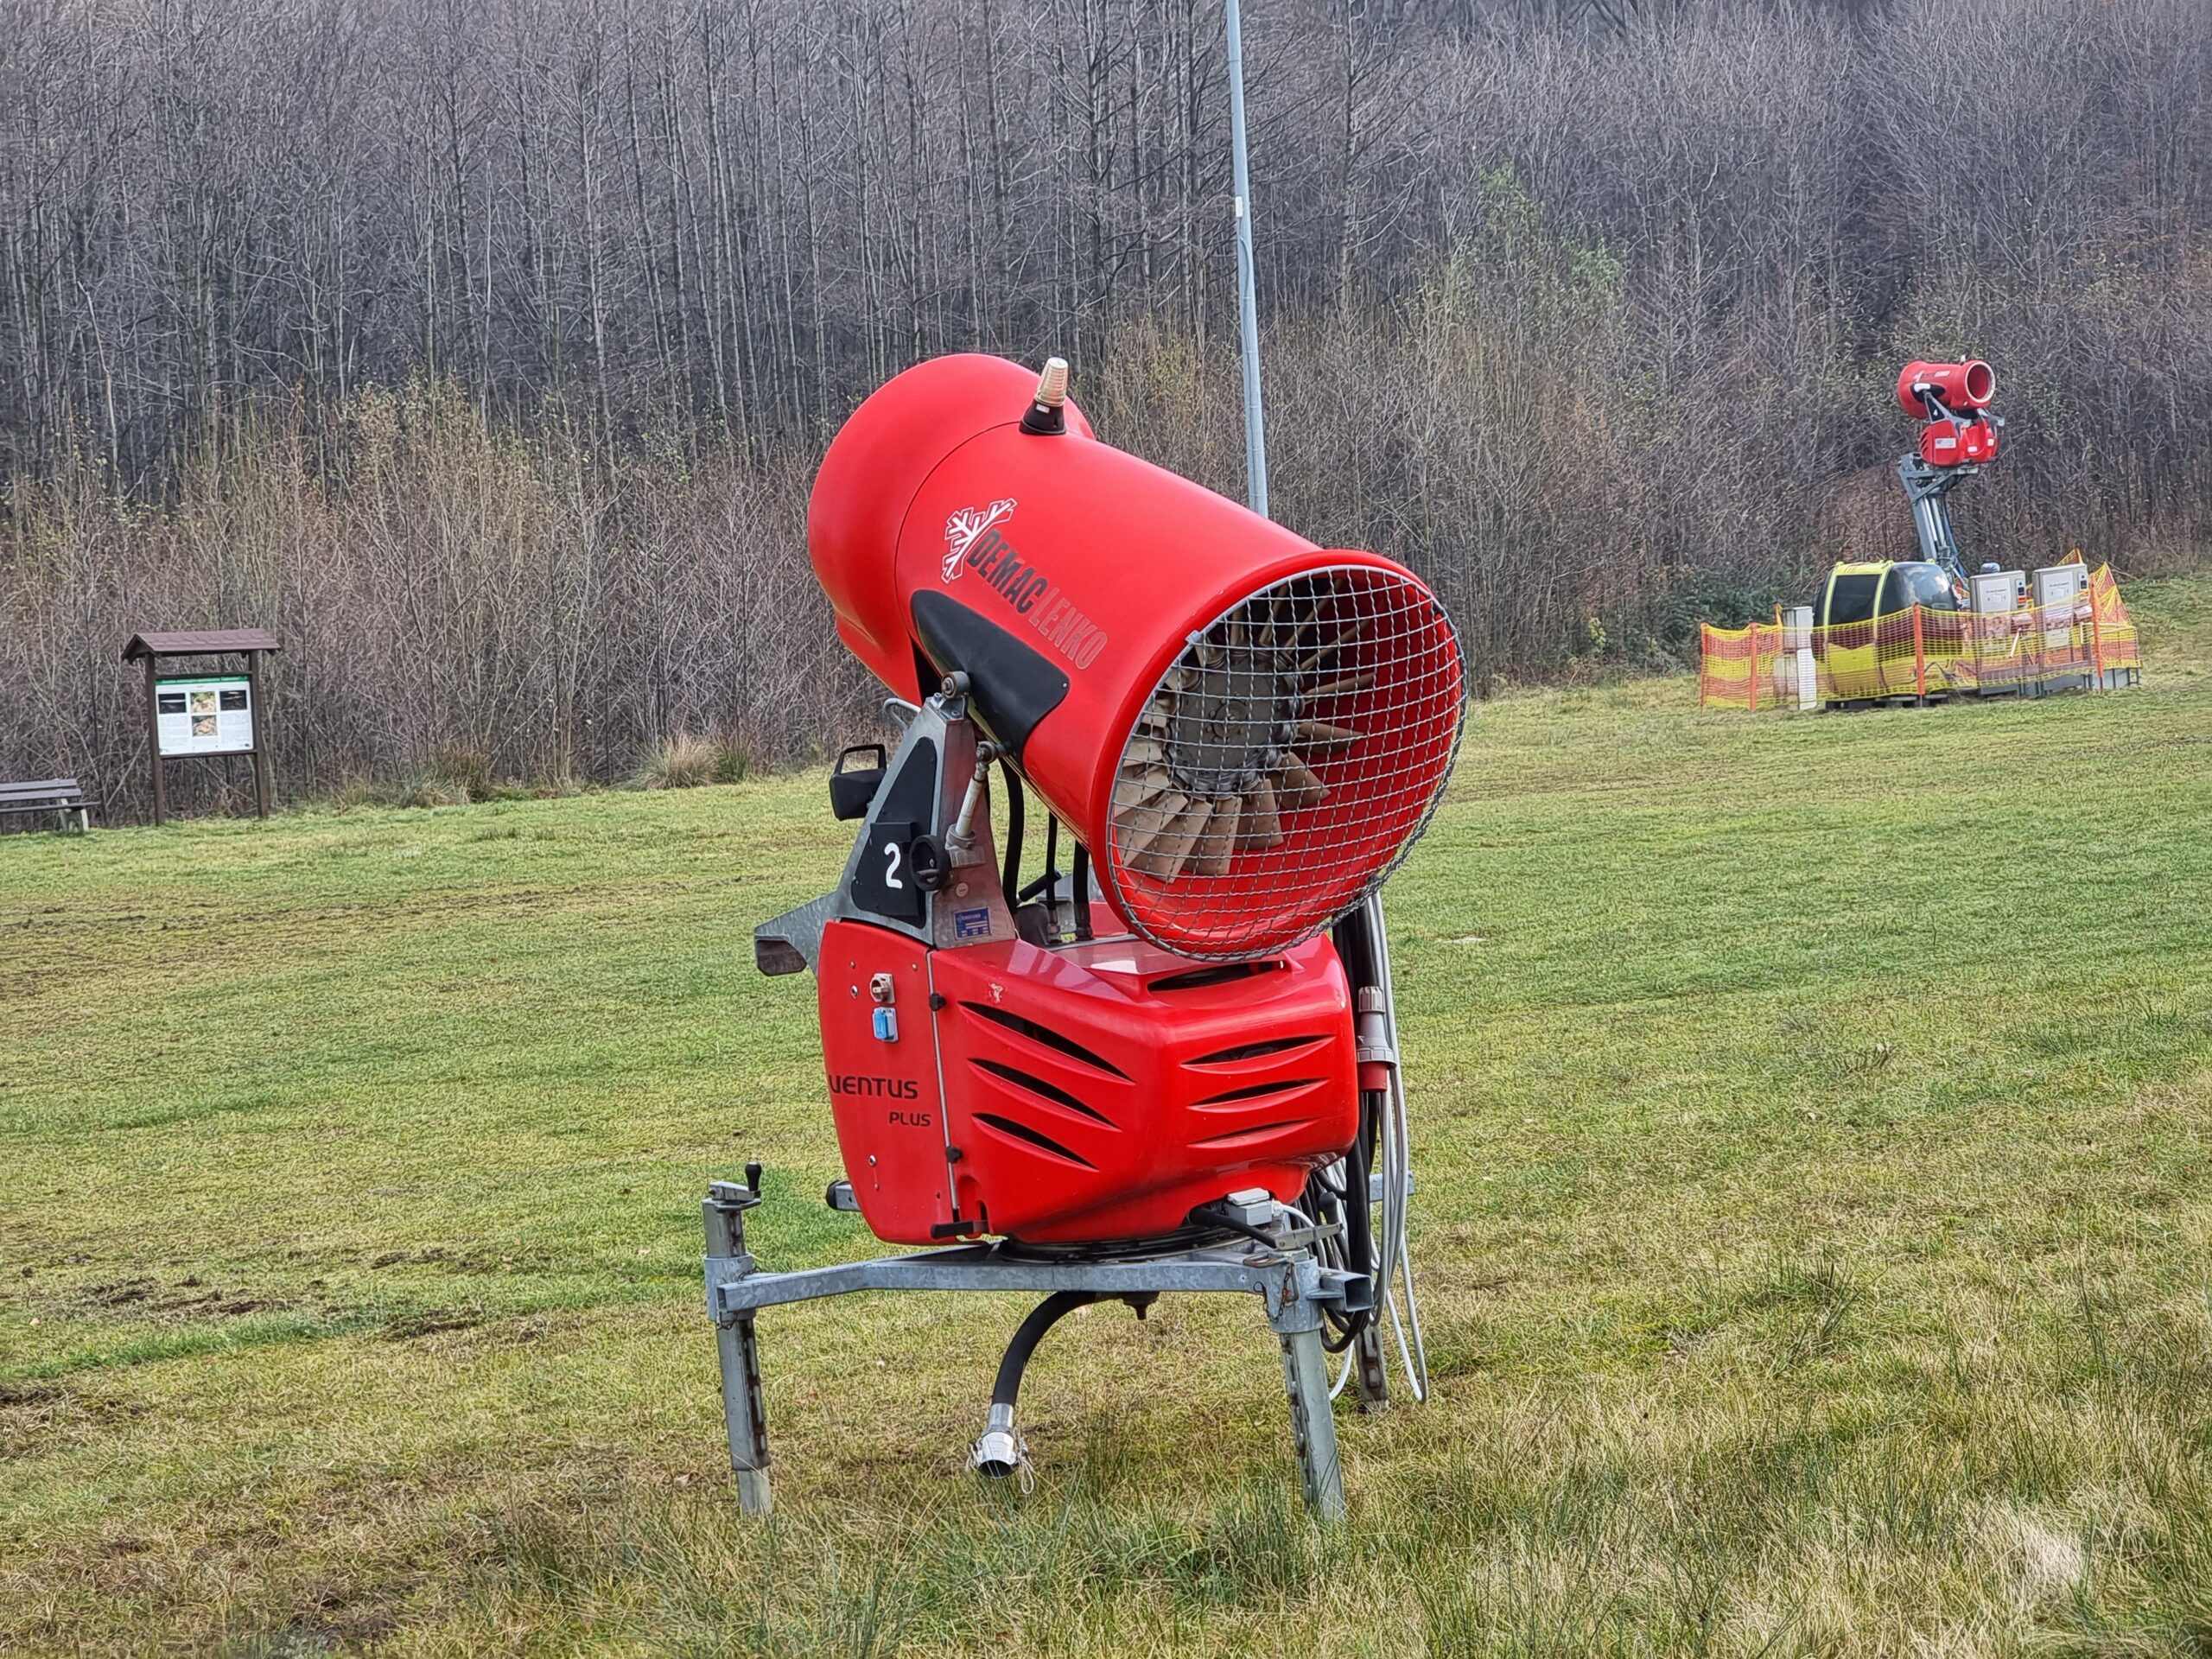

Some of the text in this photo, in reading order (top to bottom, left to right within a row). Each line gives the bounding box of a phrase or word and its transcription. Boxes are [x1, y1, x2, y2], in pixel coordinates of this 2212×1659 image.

[883, 842, 904, 889] 2
[828, 1074, 918, 1100] VENTUS
[889, 1111, 931, 1127] PLUS
